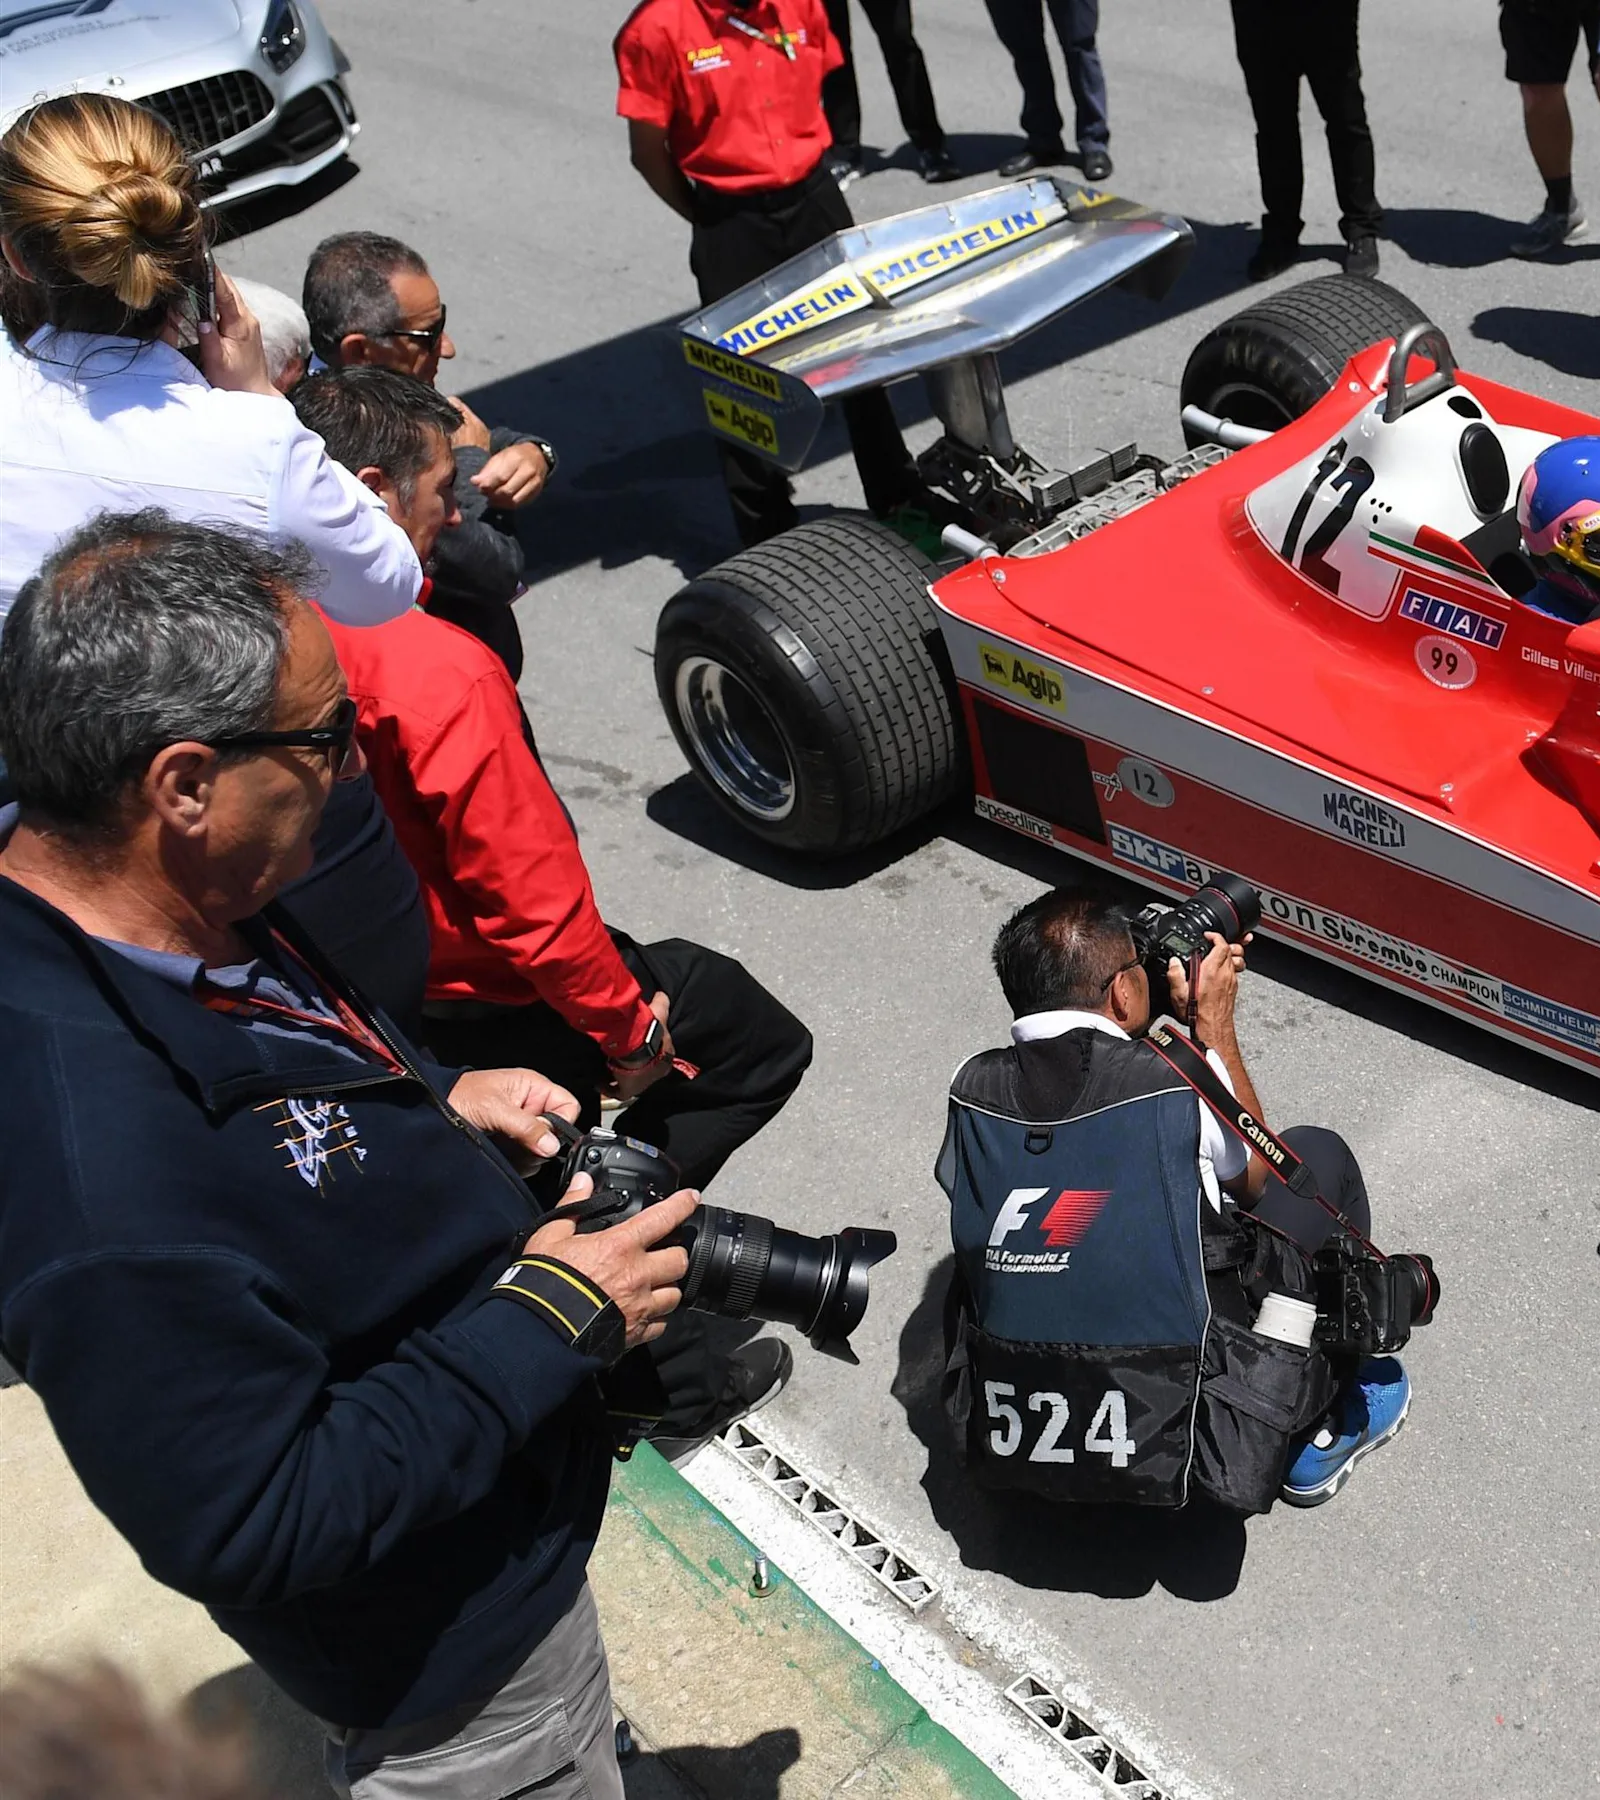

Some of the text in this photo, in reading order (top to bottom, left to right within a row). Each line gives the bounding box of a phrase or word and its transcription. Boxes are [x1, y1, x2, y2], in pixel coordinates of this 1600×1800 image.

[199, 156, 224, 178] AR
[873, 210, 1040, 286] MICHELIN
[715, 284, 858, 353] MICHELIN
[688, 342, 777, 396] MICHELIN
[730, 401, 775, 450] Agip
[1280, 437, 1375, 597] 12
[1408, 596, 1499, 642] FIAT
[1431, 646, 1459, 676] 99
[1521, 646, 1560, 671] Gilles
[1012, 659, 1063, 705] Agip
[1132, 768, 1159, 798] 12
[978, 799, 1051, 839] speedline
[1324, 793, 1405, 838] MAGNETI
[1324, 805, 1405, 847] MARELLI
[1111, 829, 1183, 872] SKF
[1339, 924, 1428, 974] brembo
[1430, 965, 1501, 1003] CHAMPION
[1237, 1112, 1286, 1165] Canon
[1001, 1250, 1059, 1265] Formula
[1058, 1251, 1072, 1264] 1
[984, 1379, 1137, 1468] 524
